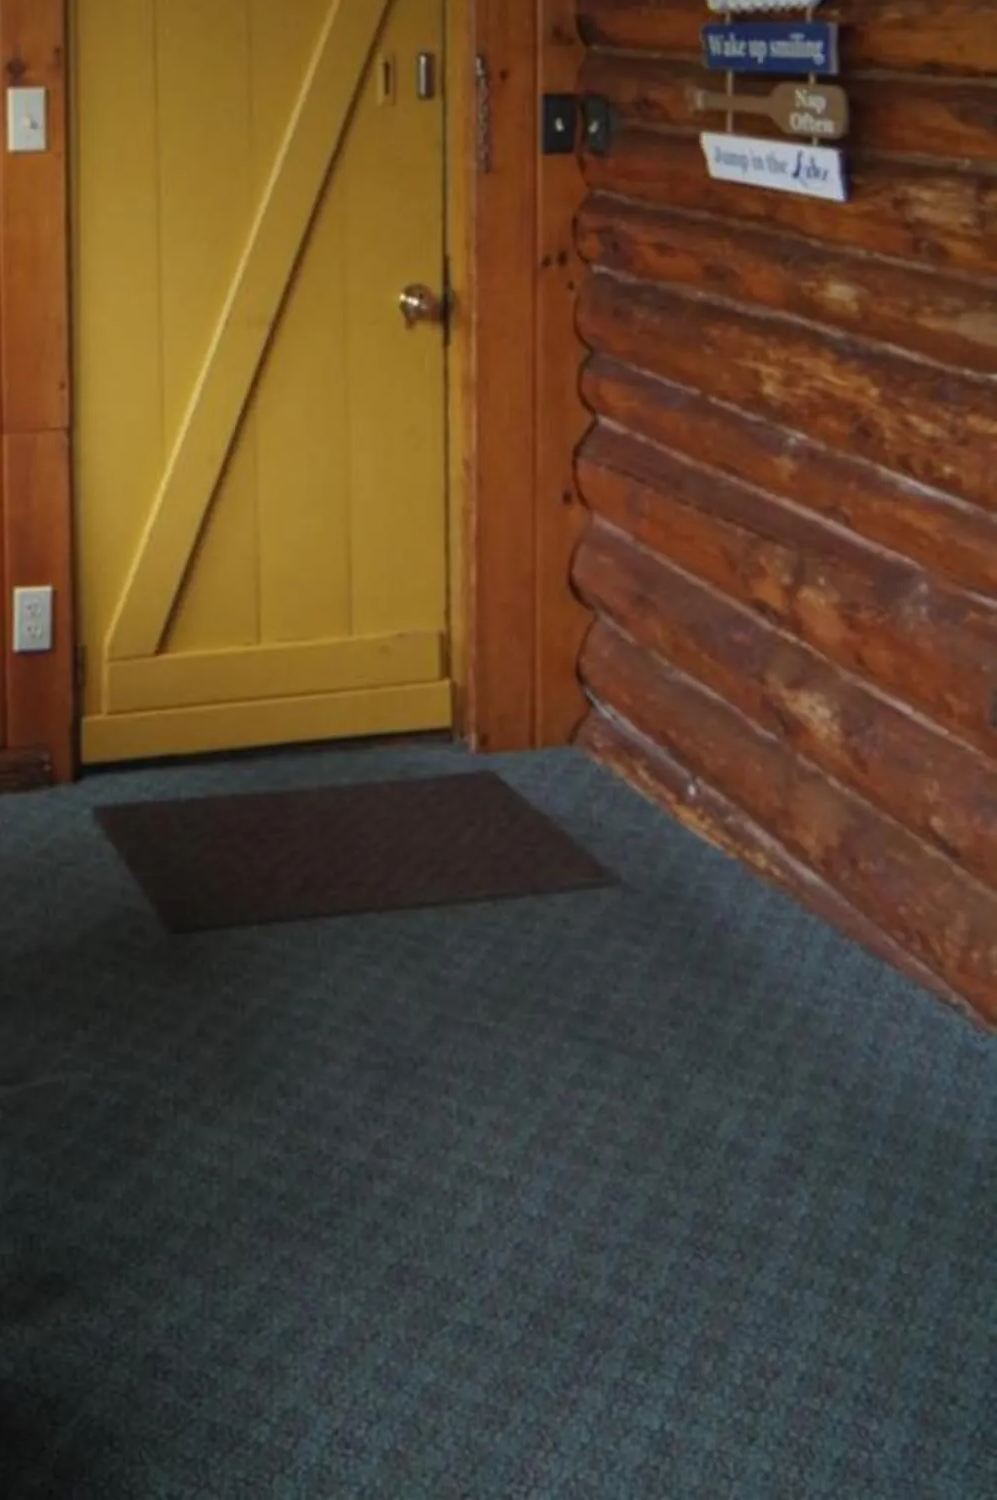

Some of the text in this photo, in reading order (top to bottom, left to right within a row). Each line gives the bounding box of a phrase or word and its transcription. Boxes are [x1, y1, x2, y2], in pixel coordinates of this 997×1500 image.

[708, 33, 746, 57] Wake
[749, 40, 767, 64] up
[751, 149, 764, 170] in
[766, 152, 788, 174] the
